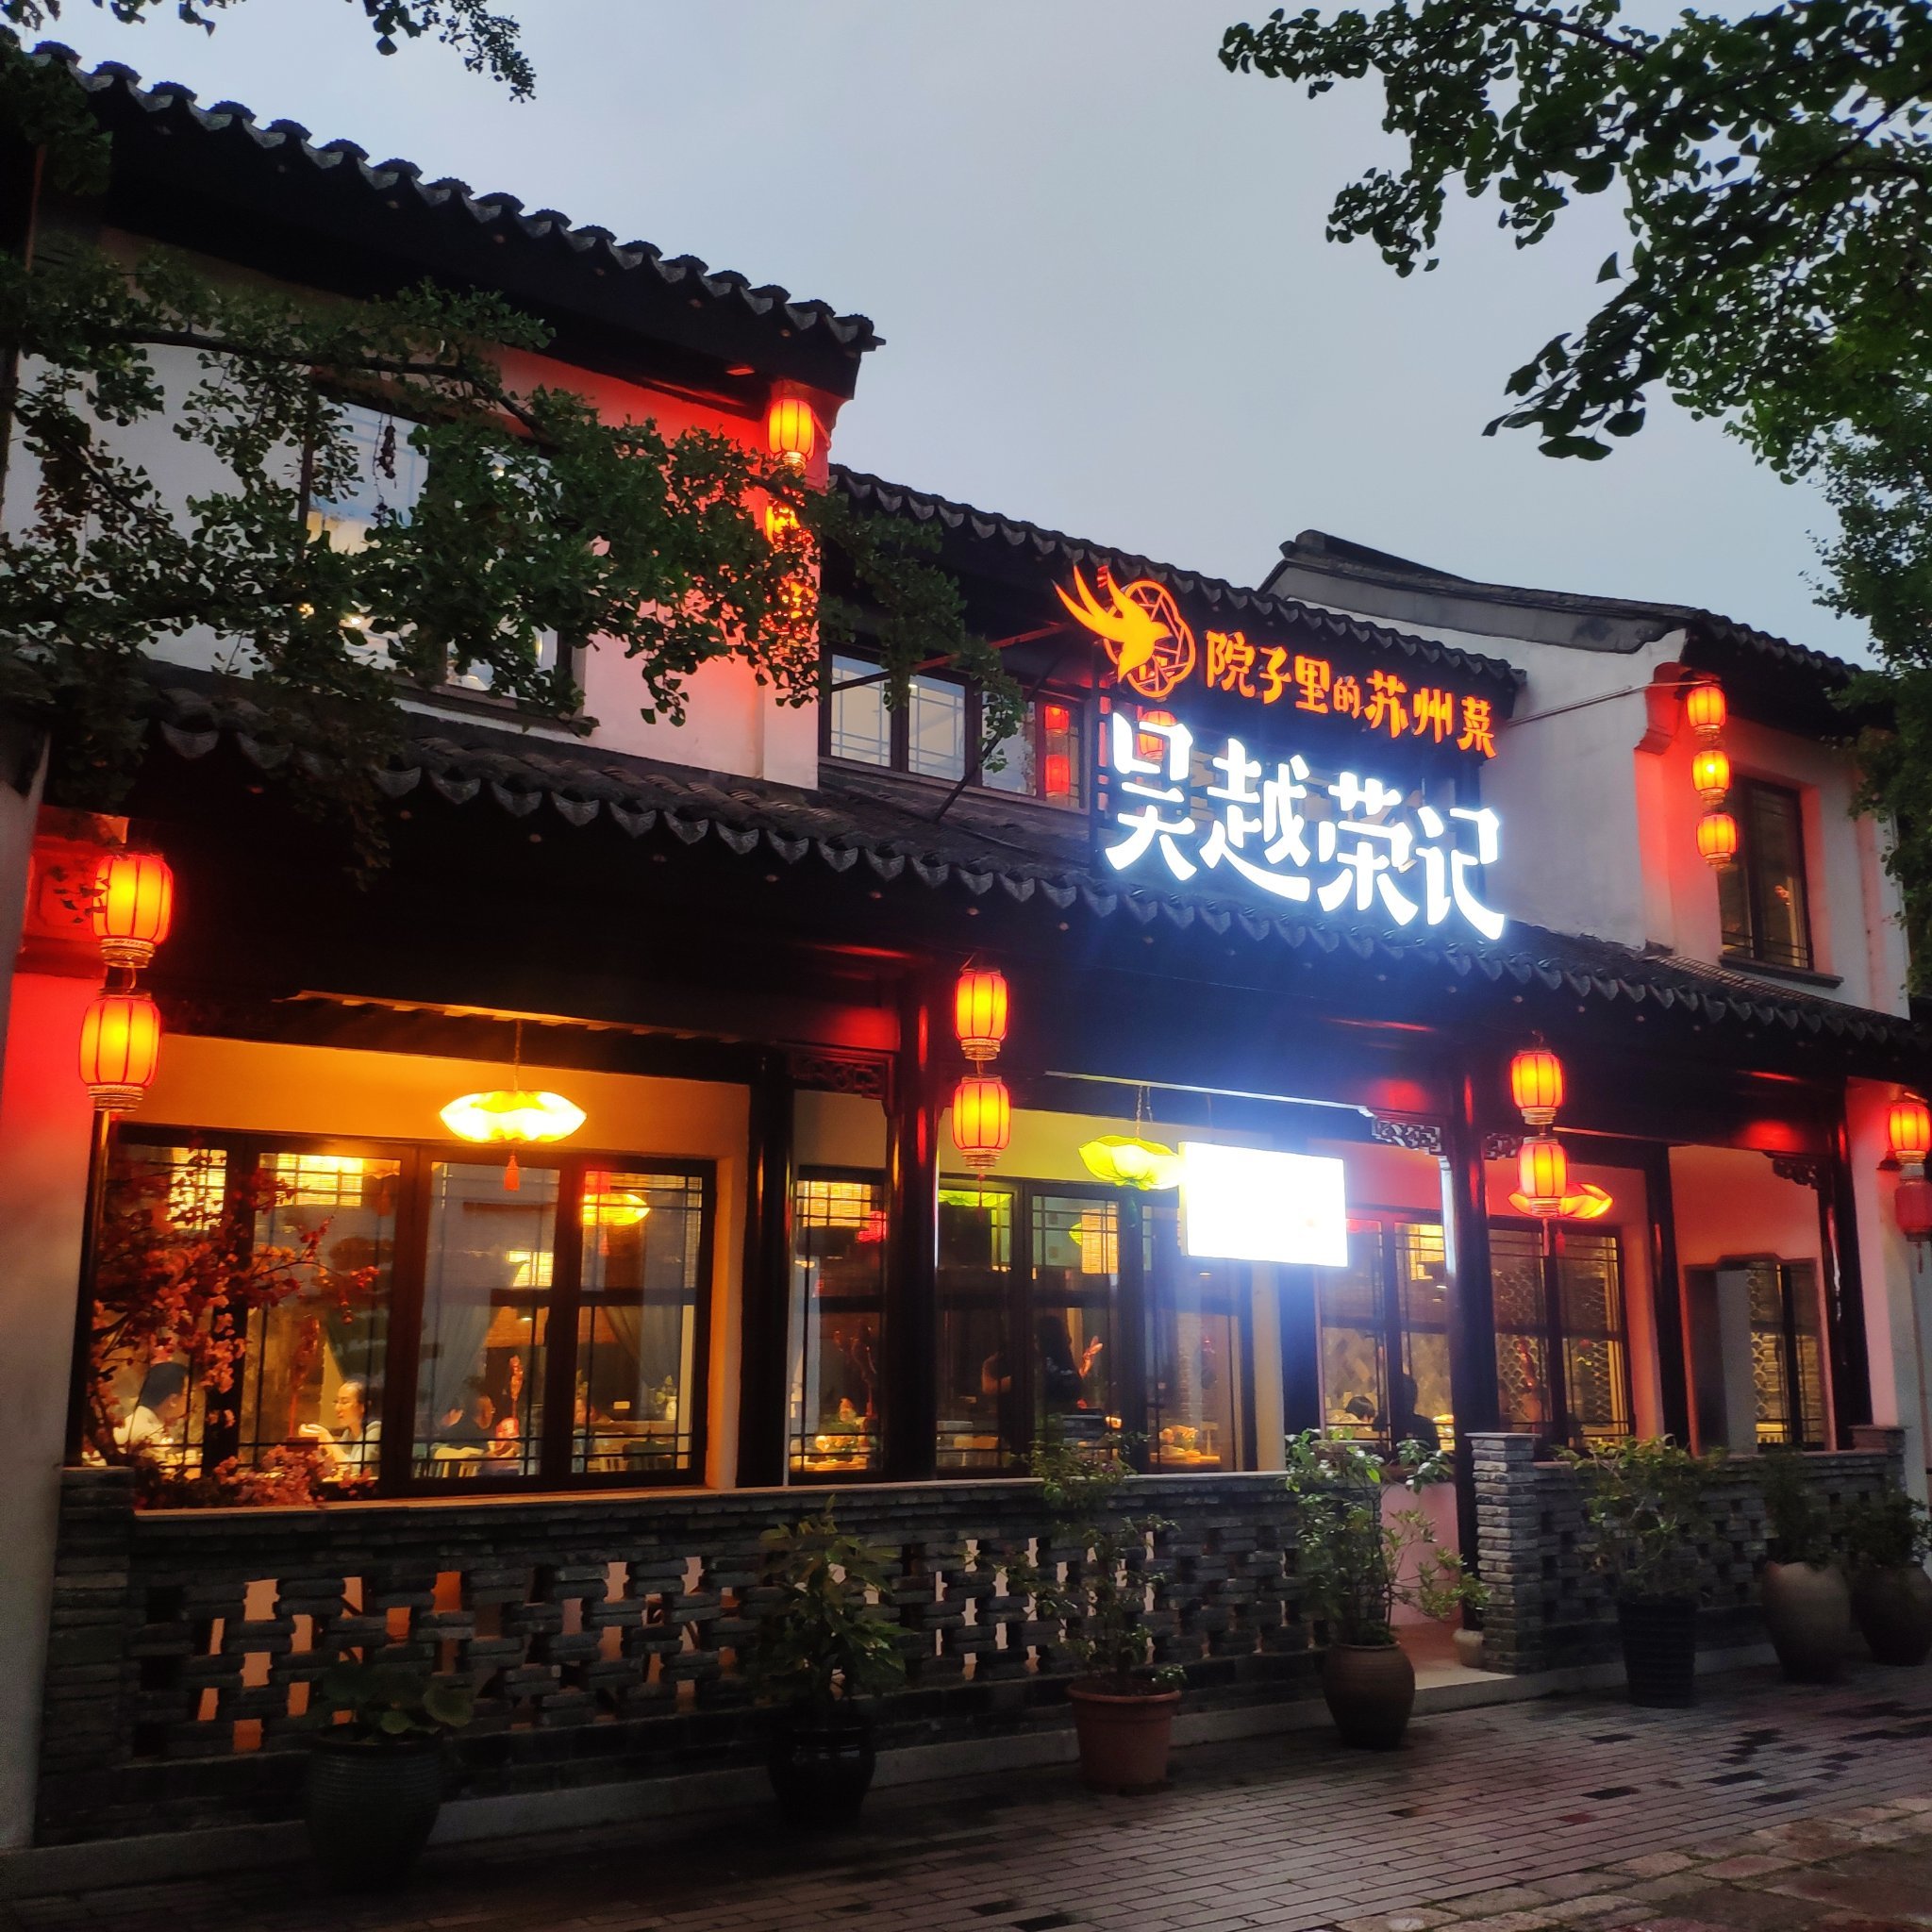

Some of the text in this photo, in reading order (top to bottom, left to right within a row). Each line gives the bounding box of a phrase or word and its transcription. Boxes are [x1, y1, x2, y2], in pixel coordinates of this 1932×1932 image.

[1206, 630, 1497, 758] 院子里的苏州菜
[1106, 712, 1506, 941] 吴越荣记
